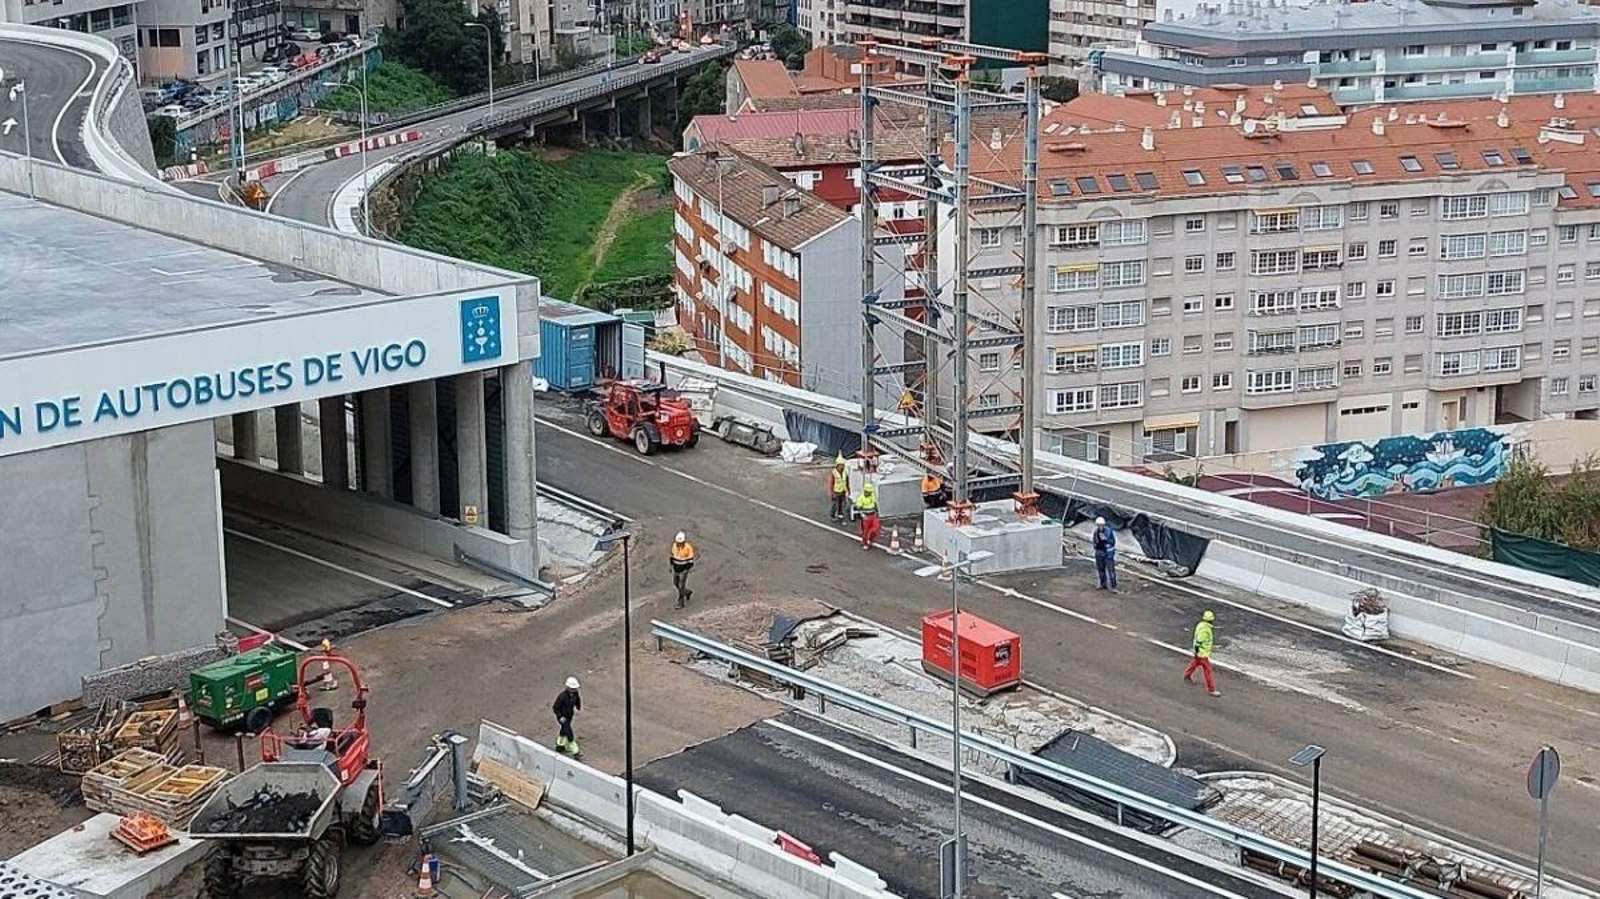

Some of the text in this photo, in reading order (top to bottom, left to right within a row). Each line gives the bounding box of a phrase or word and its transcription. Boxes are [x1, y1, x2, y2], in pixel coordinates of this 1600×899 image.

[36, 397, 82, 432] DE
[94, 361, 293, 422] AUTOBUSES
[303, 353, 343, 386] DE
[351, 339, 427, 376] VIGO
